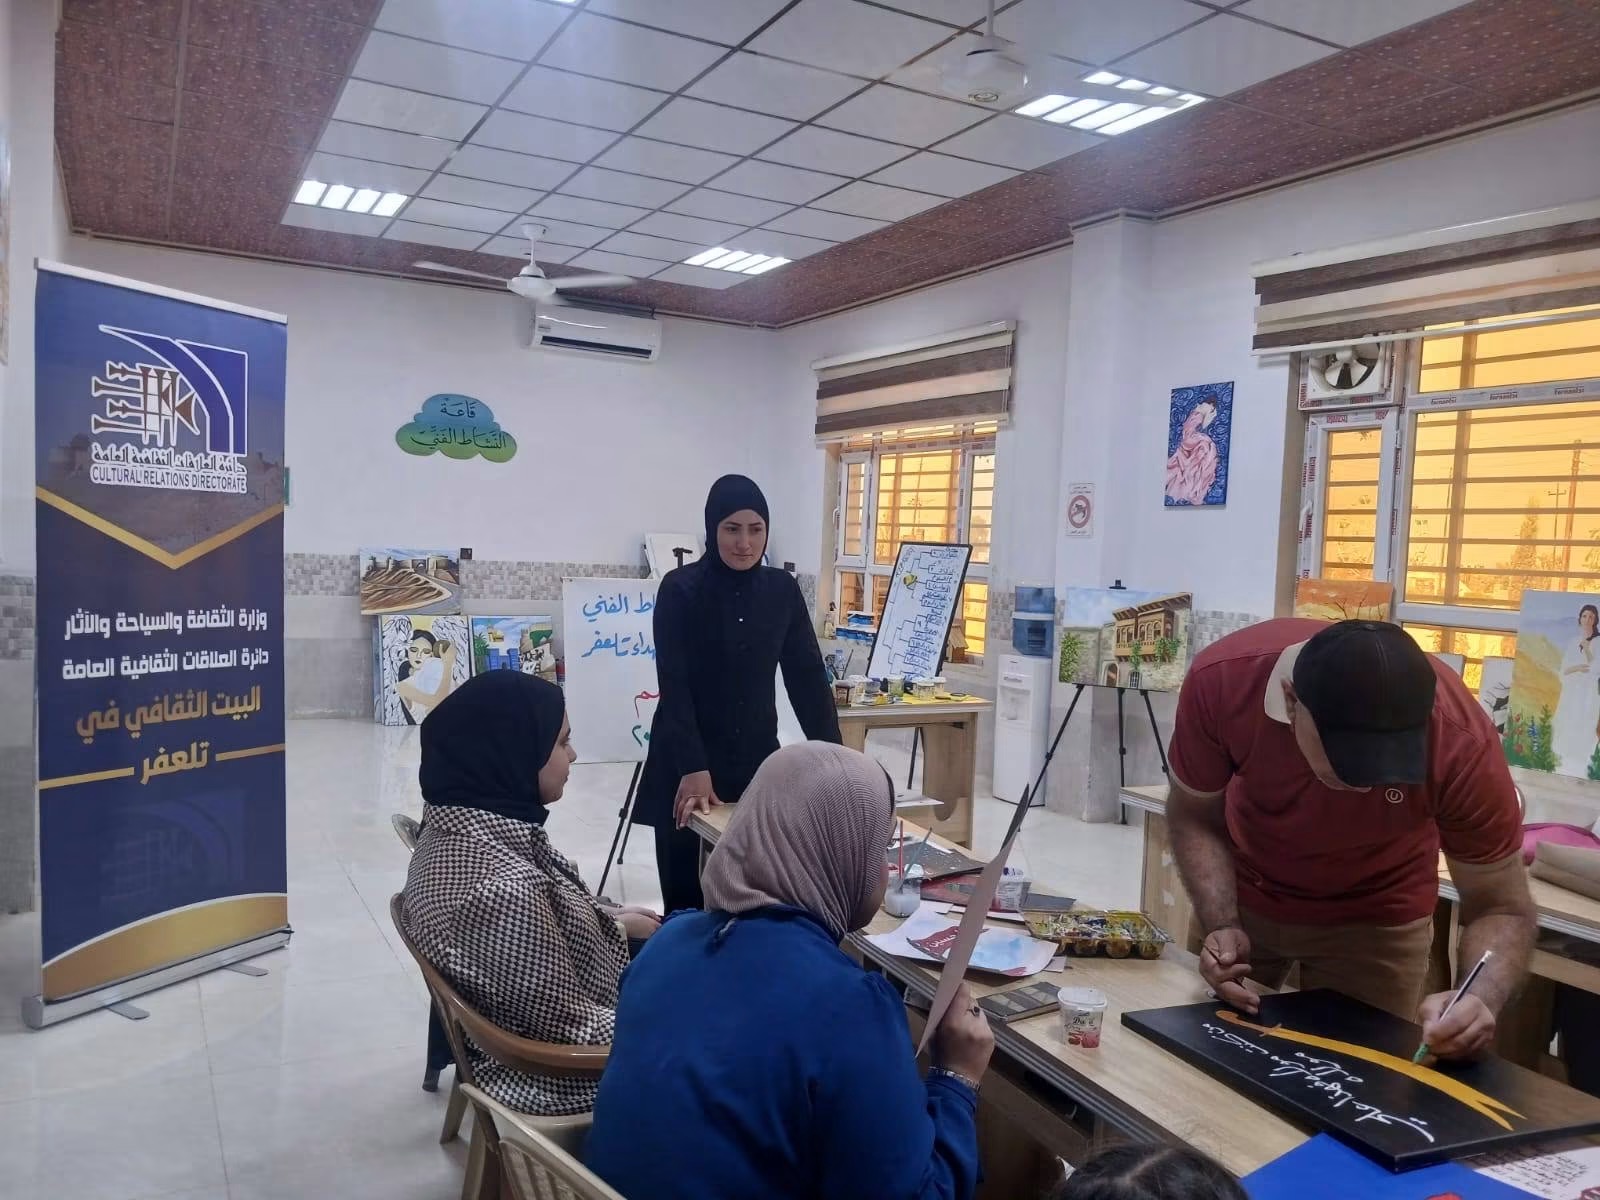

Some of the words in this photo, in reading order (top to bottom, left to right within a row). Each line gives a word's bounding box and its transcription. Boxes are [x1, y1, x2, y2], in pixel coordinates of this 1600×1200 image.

[92, 466, 141, 483] CULTURAL
[143, 471, 190, 488] RELATIONS
[192, 474, 246, 492] DIRECTORATE
[64, 608, 111, 640] والآثار
[115, 611, 183, 636] والسياحة
[186, 604, 235, 629] الثقافة
[238, 608, 268, 631] وزارة
[62, 657, 115, 680] العامة
[120, 648, 178, 679] الثقافية
[182, 649, 237, 670] العلاقات
[241, 647, 269, 670] دائرة
[124, 688, 208, 739] الثقافي
[211, 685, 261, 720] البيت
[76, 700, 120, 744] في
[140, 741, 210, 785] تلعفر
